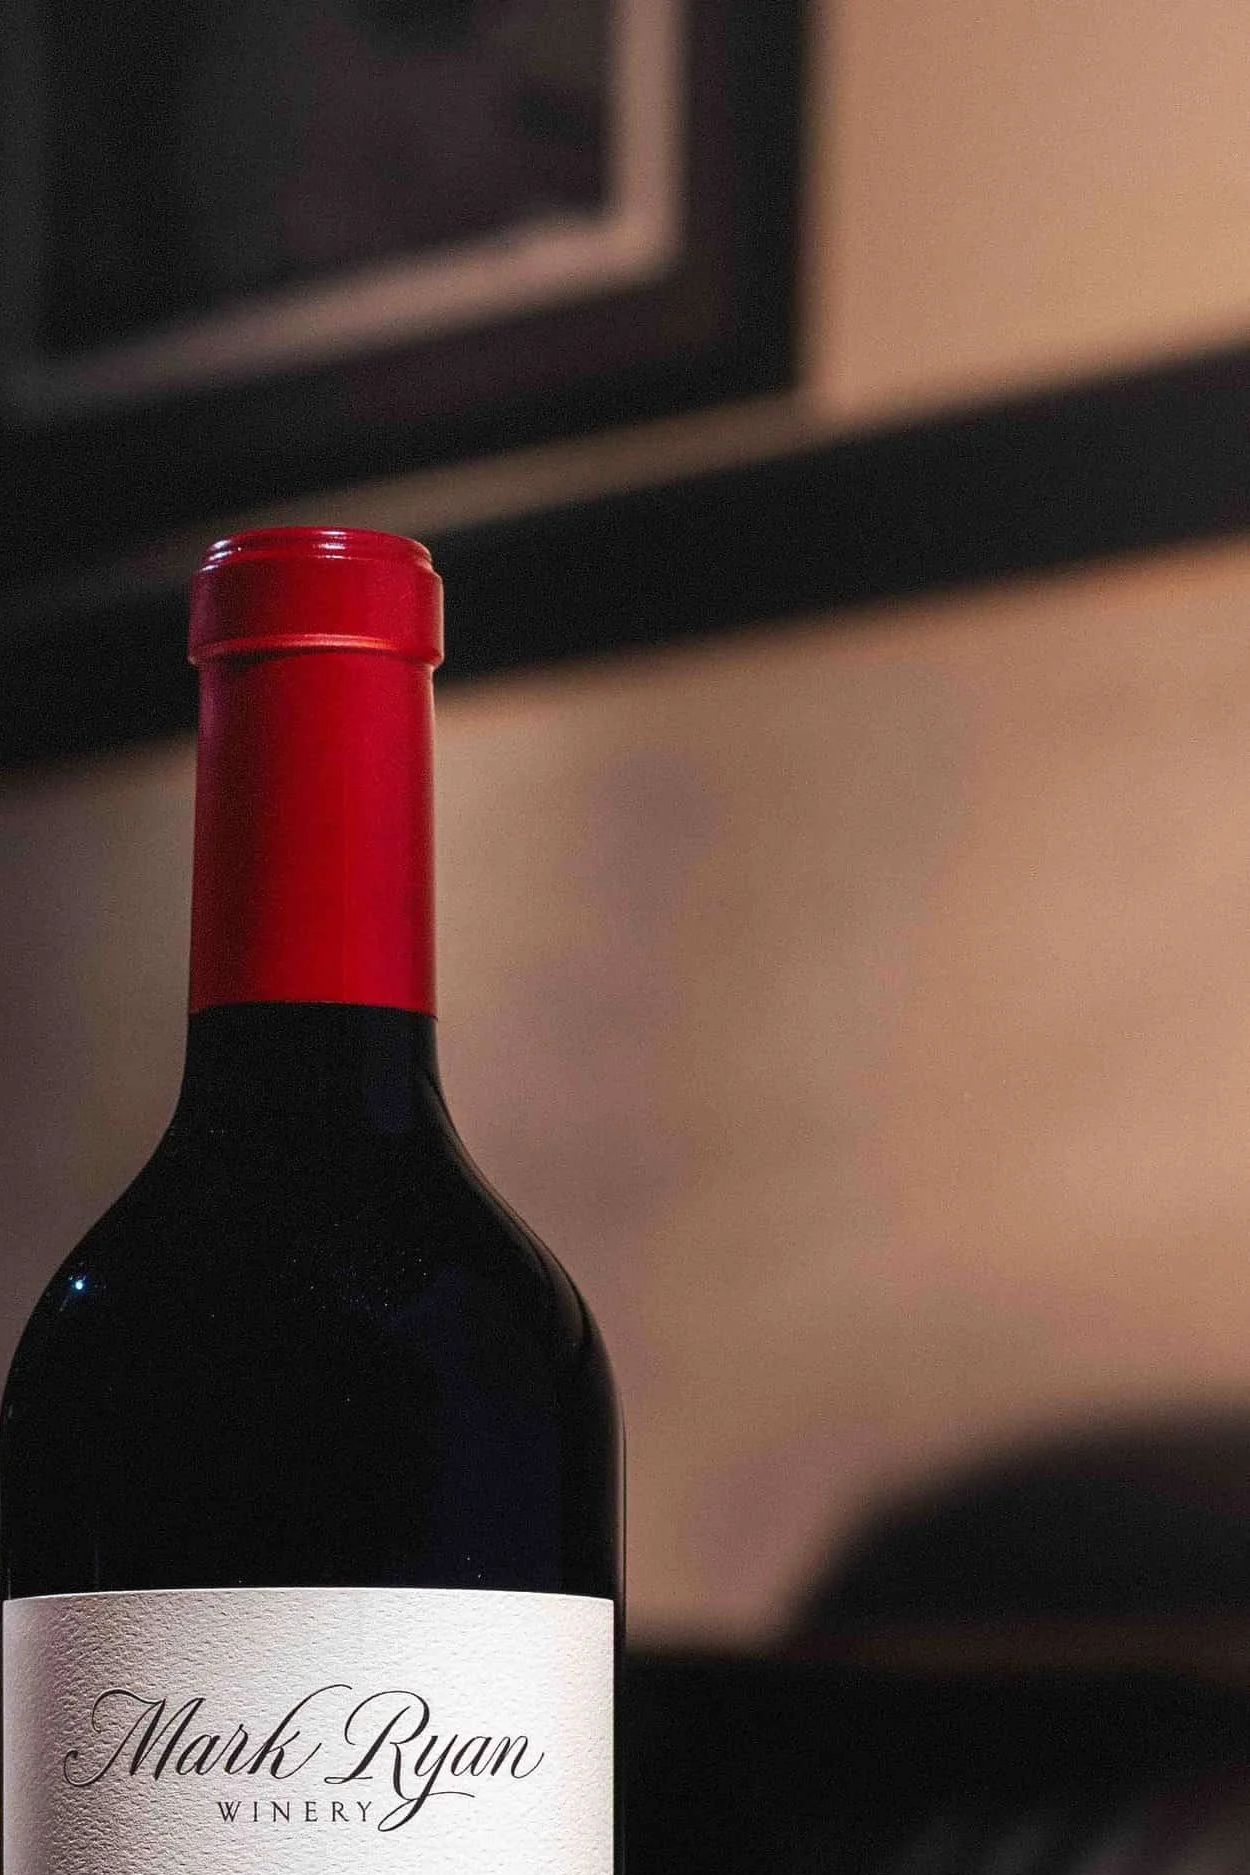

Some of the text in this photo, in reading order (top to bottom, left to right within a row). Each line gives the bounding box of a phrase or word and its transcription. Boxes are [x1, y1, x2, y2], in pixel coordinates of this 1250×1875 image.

[63, 1683, 545, 1833] Mark Ryan
[217, 1800, 374, 1823] WINERY
